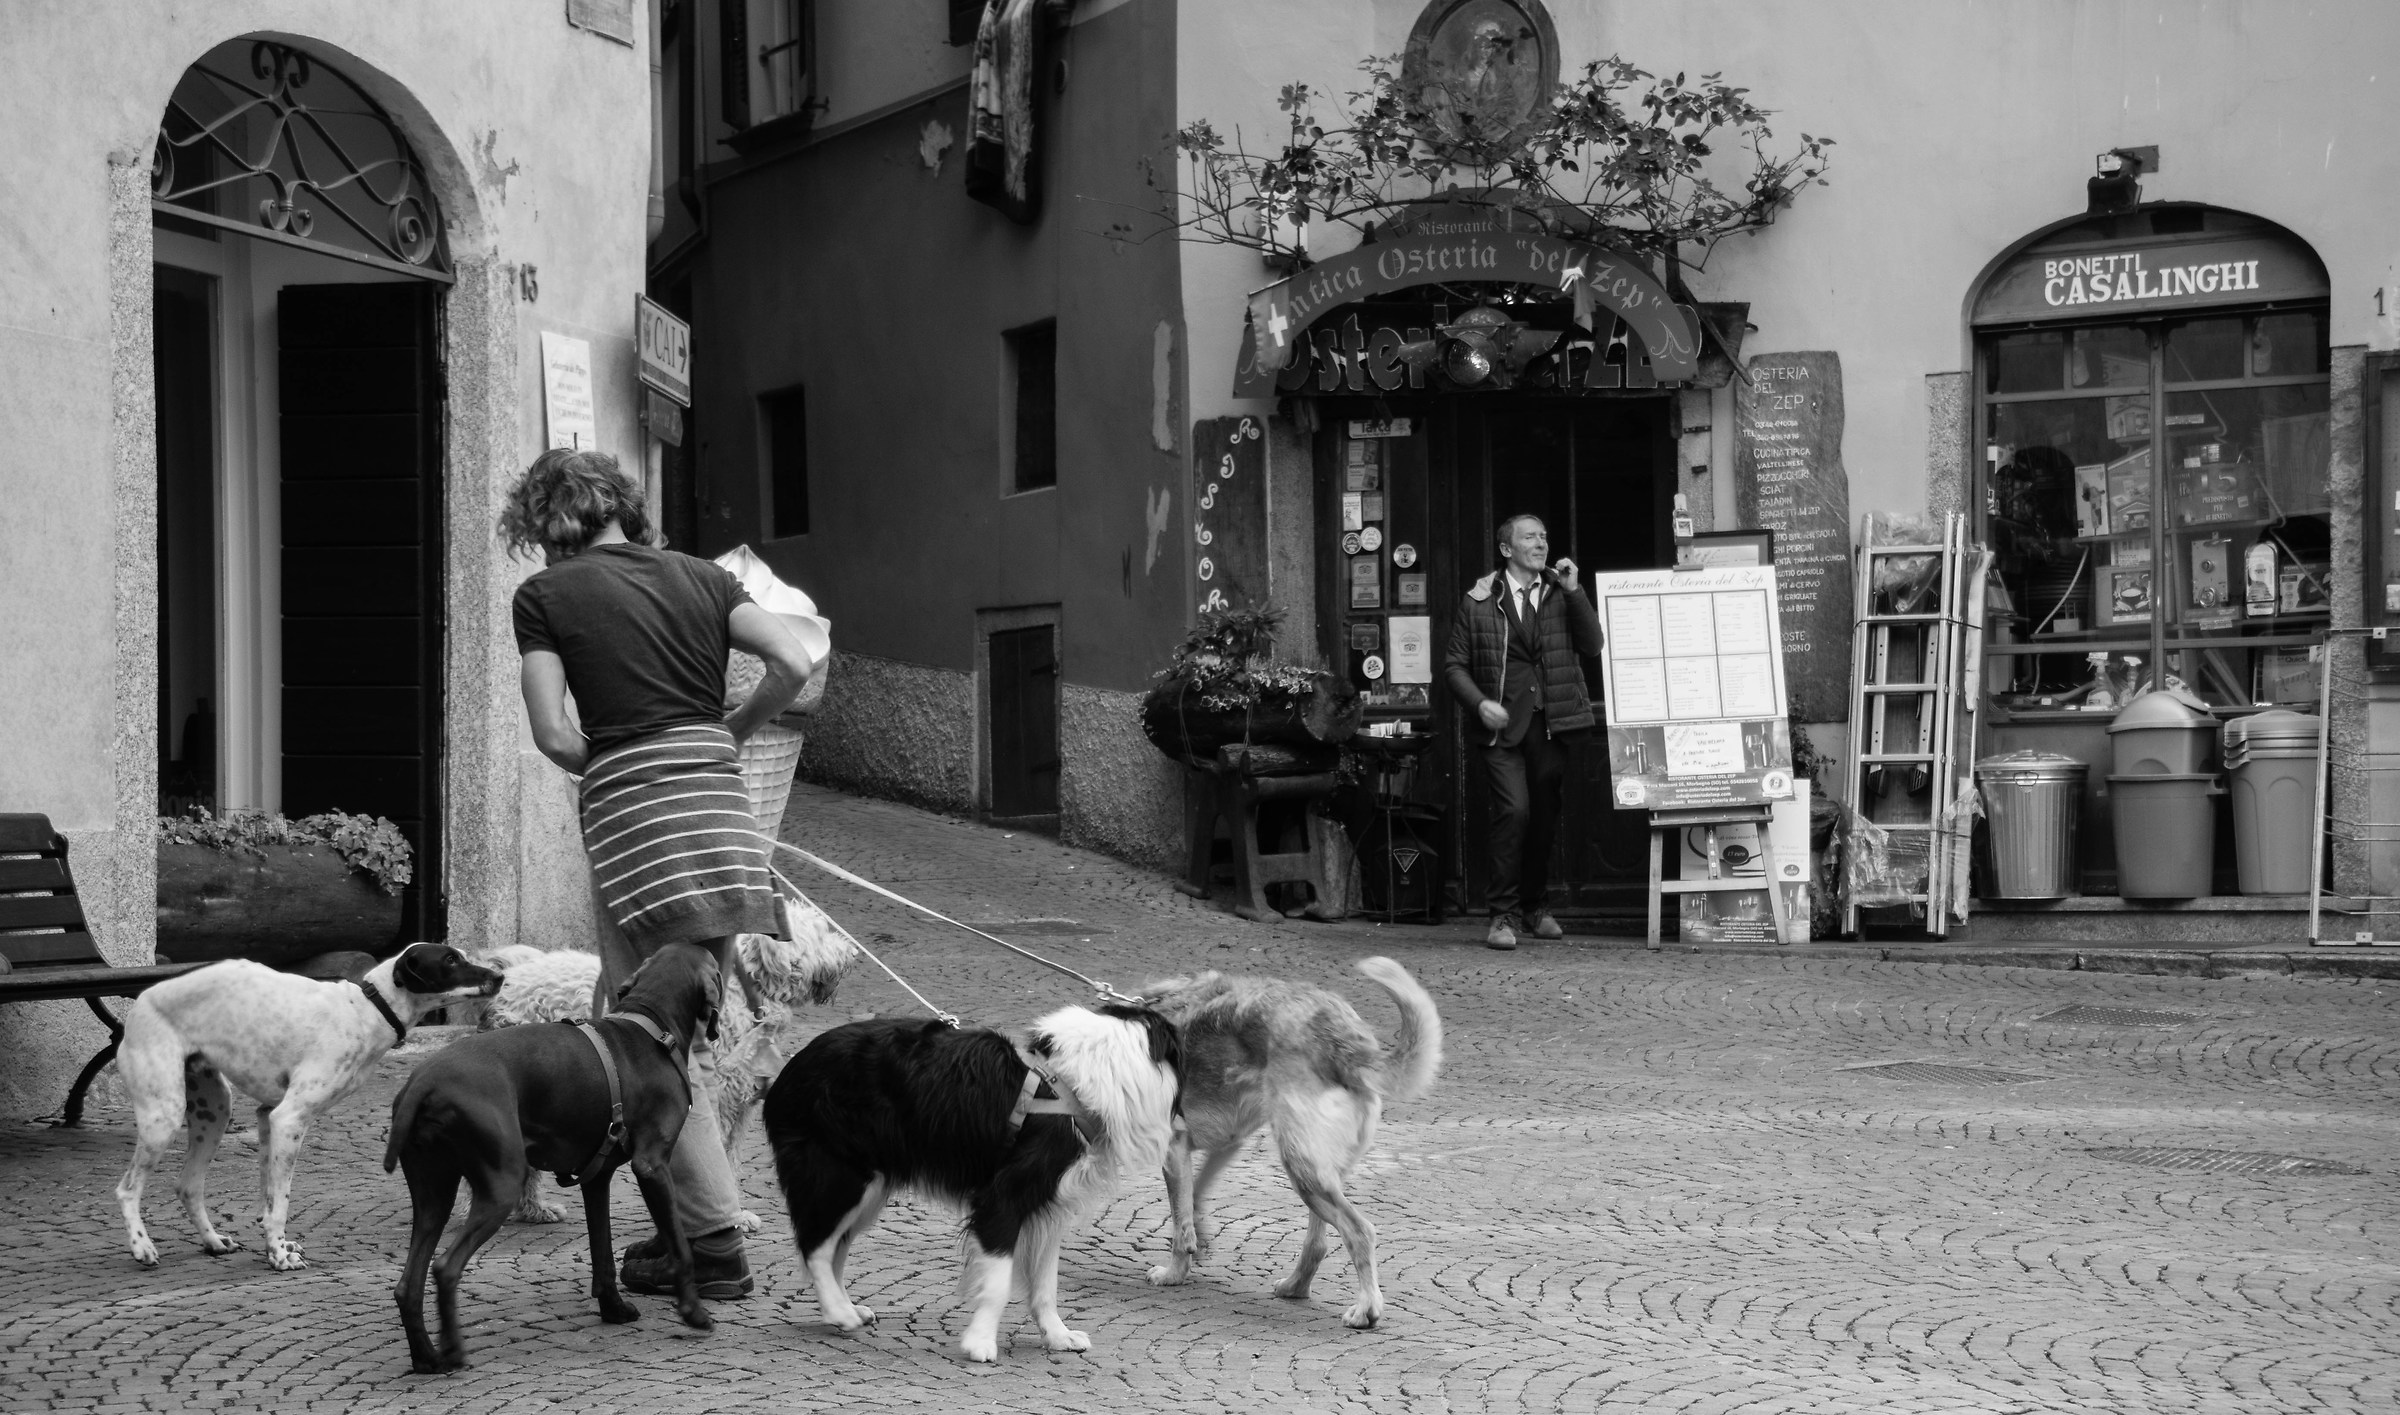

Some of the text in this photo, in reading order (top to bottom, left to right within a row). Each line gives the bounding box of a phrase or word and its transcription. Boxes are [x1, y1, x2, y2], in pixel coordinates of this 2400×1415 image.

[1417, 219, 1495, 237] Ristorante
[2045, 252, 2141, 279] BONETTI
[518, 262, 540, 304] 13
[1289, 264, 1364, 326] ntica
[1377, 237, 1498, 281] Osteria
[2044, 260, 2260, 307] CASALINGHI
[654, 316, 677, 369] CAI
[1751, 366, 1810, 382] OSTERIA
[1754, 382, 1776, 394] DEL
[1773, 394, 1804, 410] ZEP
[1760, 484, 1788, 496] SCIAT
[1607, 577, 1664, 591] ristorante
[1715, 573, 1735, 586] del
